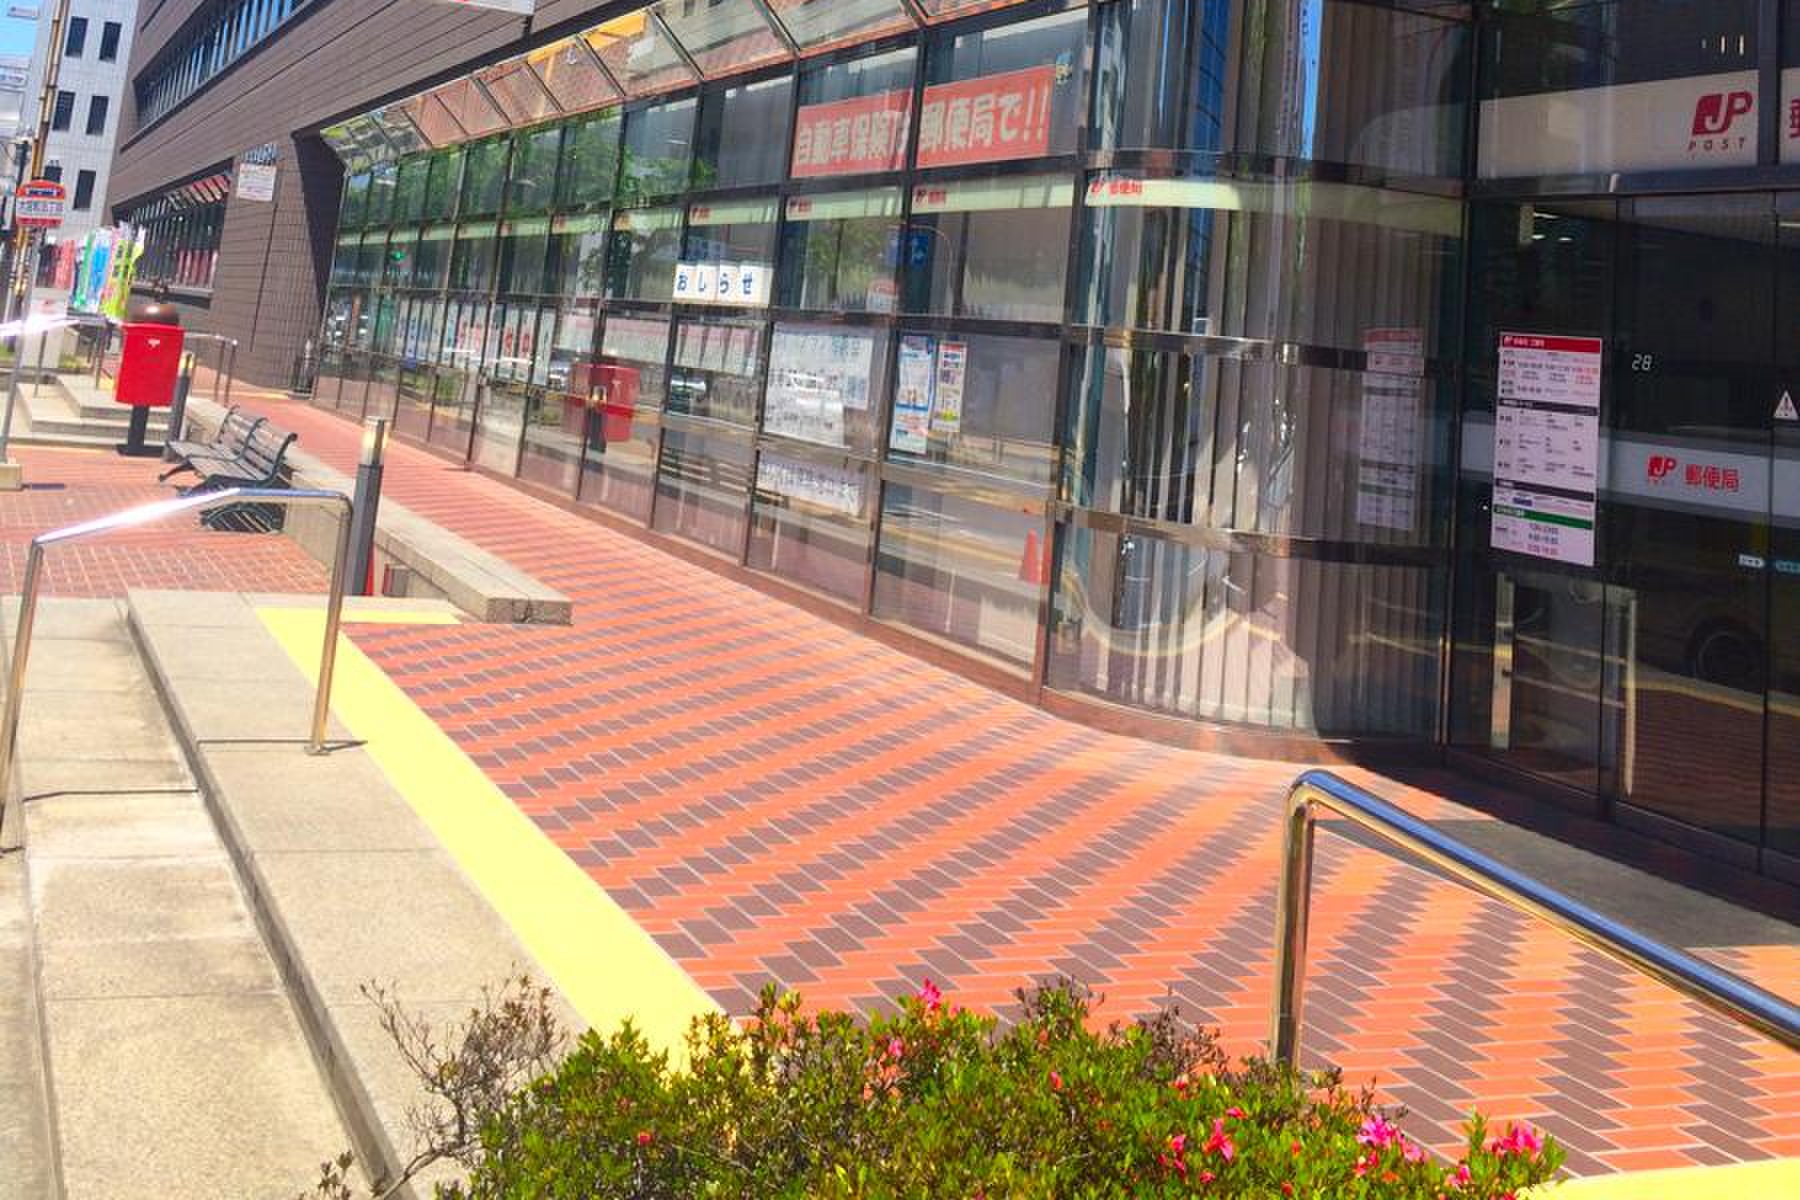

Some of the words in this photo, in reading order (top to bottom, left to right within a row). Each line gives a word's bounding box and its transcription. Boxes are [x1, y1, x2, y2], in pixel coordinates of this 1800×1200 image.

[1692, 91, 1753, 136] JP
[1687, 137, 1745, 153] POST
[1631, 353, 1652, 371] 28
[1685, 464, 1740, 492] 郵便局
